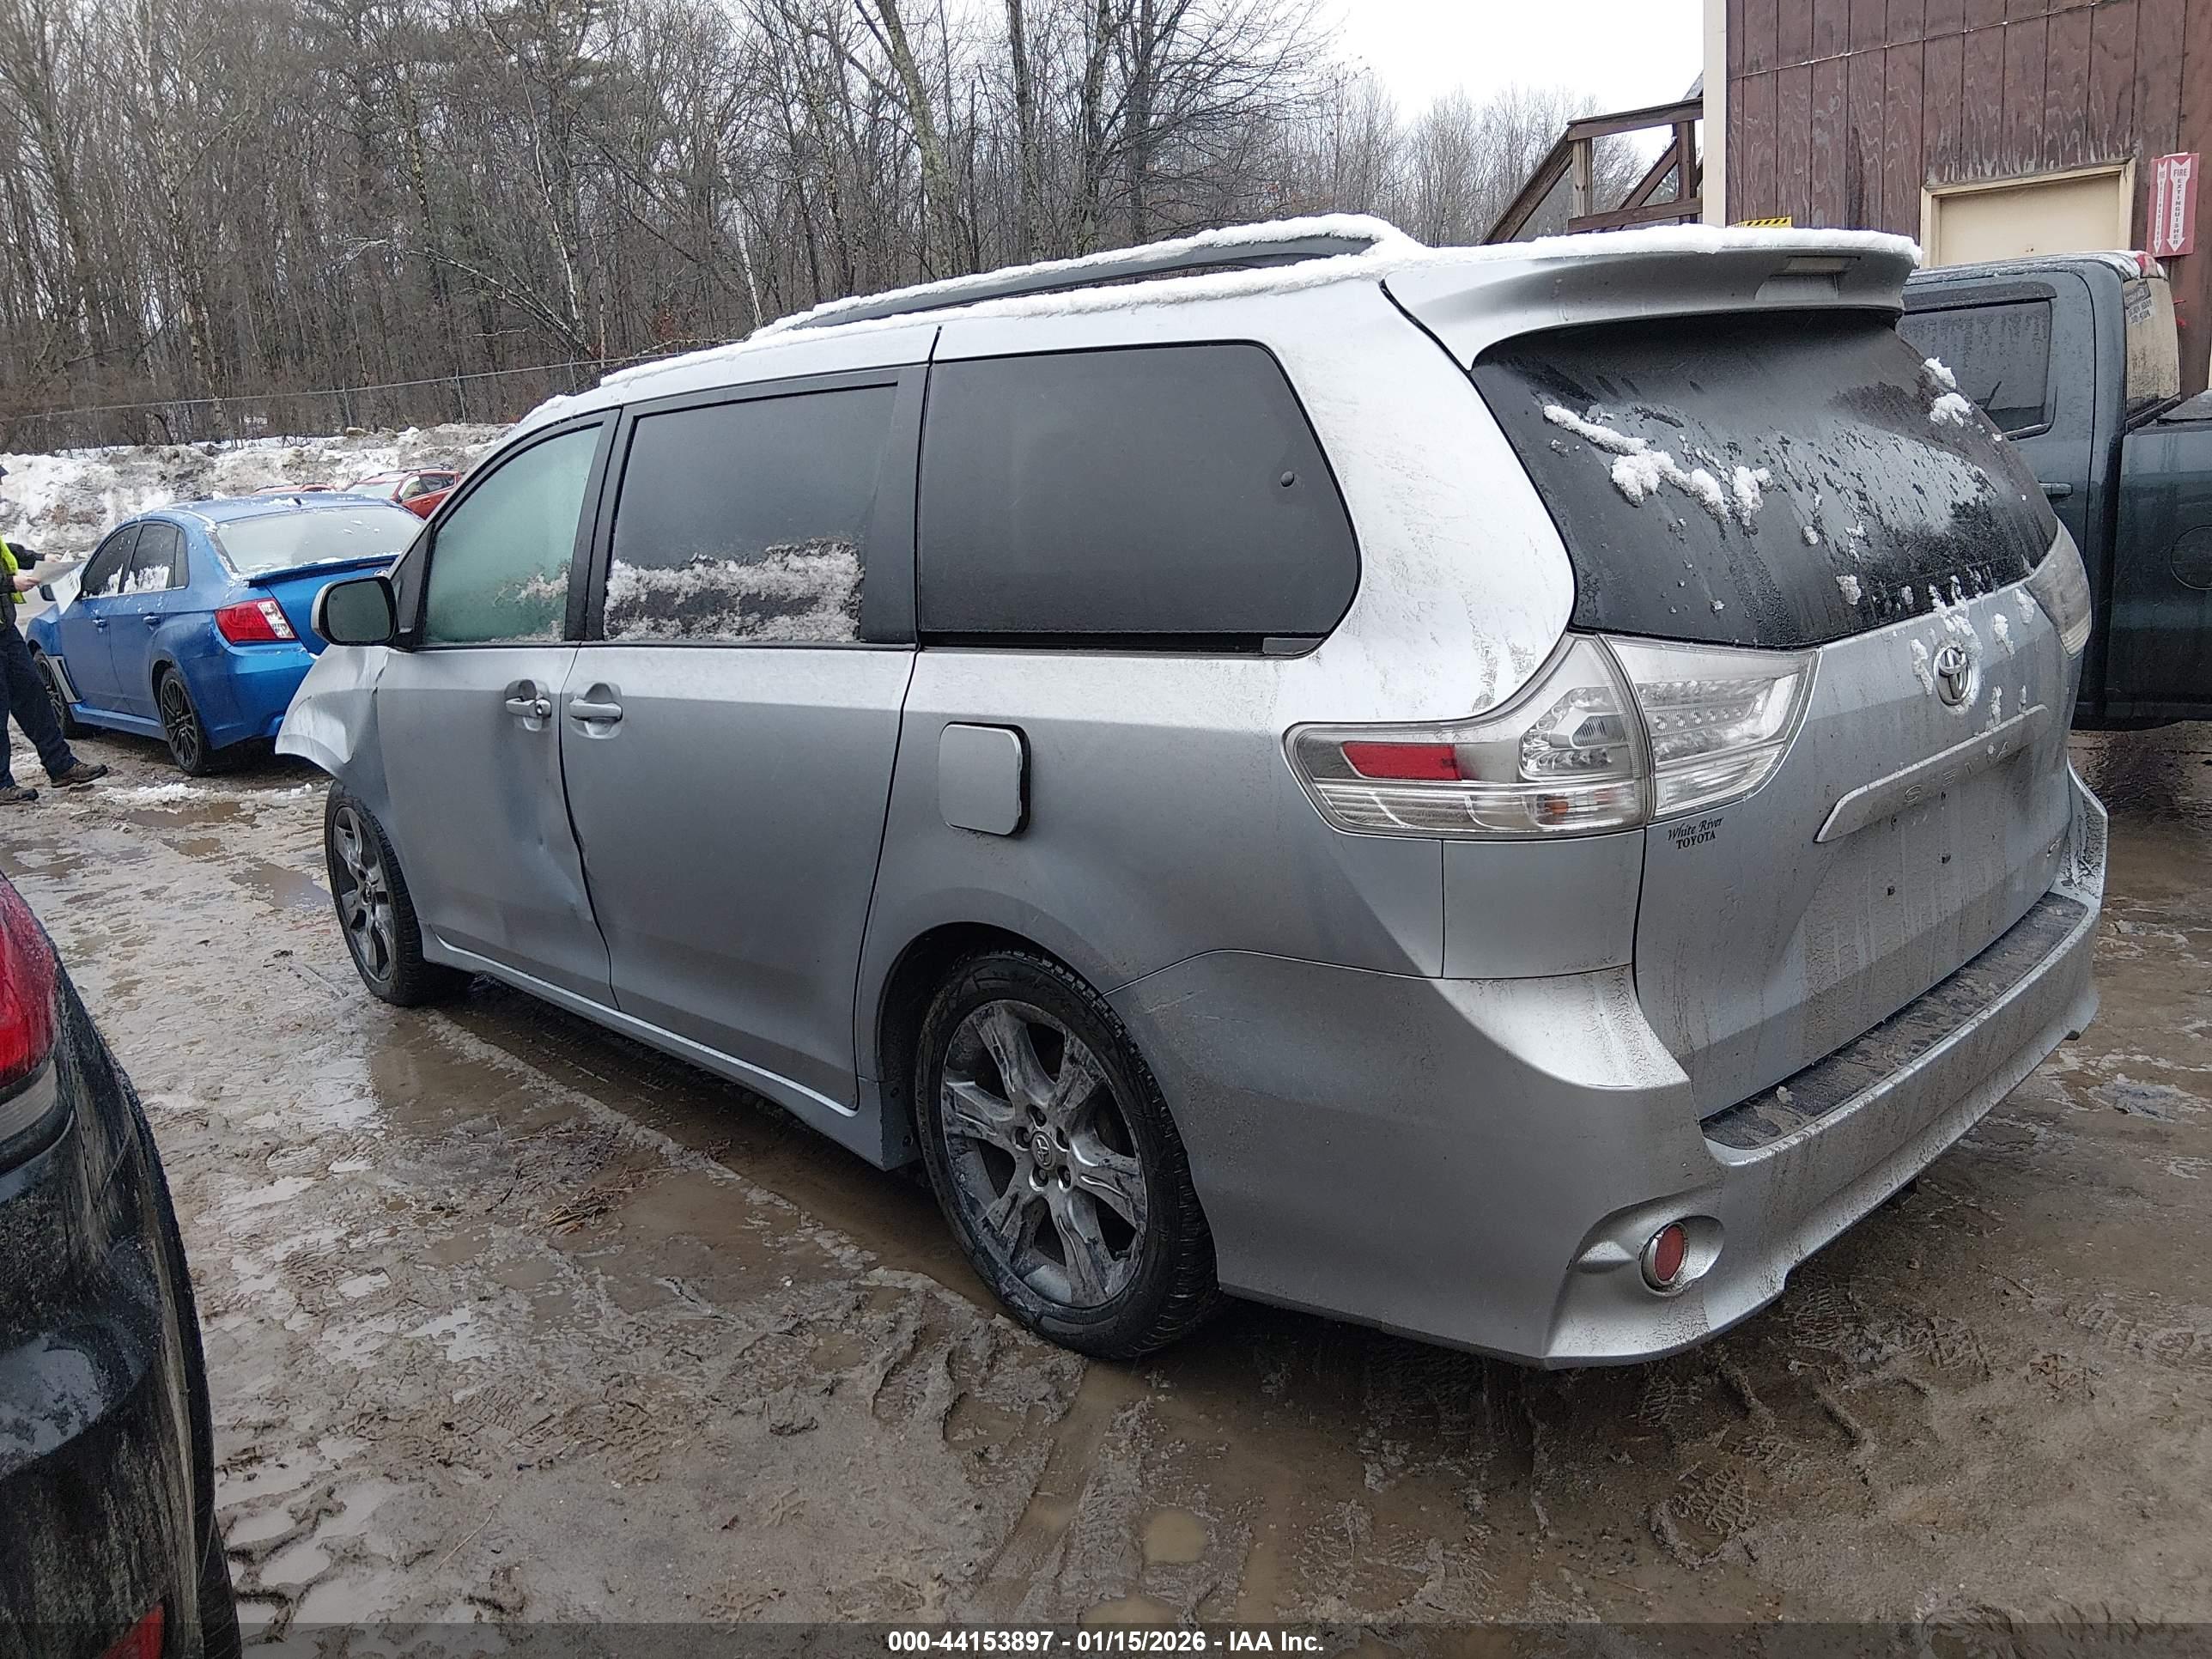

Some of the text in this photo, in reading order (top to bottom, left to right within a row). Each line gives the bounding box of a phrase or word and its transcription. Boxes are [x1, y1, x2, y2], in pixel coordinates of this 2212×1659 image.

[2173, 168, 2188, 177] FIRE
[1668, 817, 1724, 841] White River
[1676, 830, 1716, 849] TOYOTA
